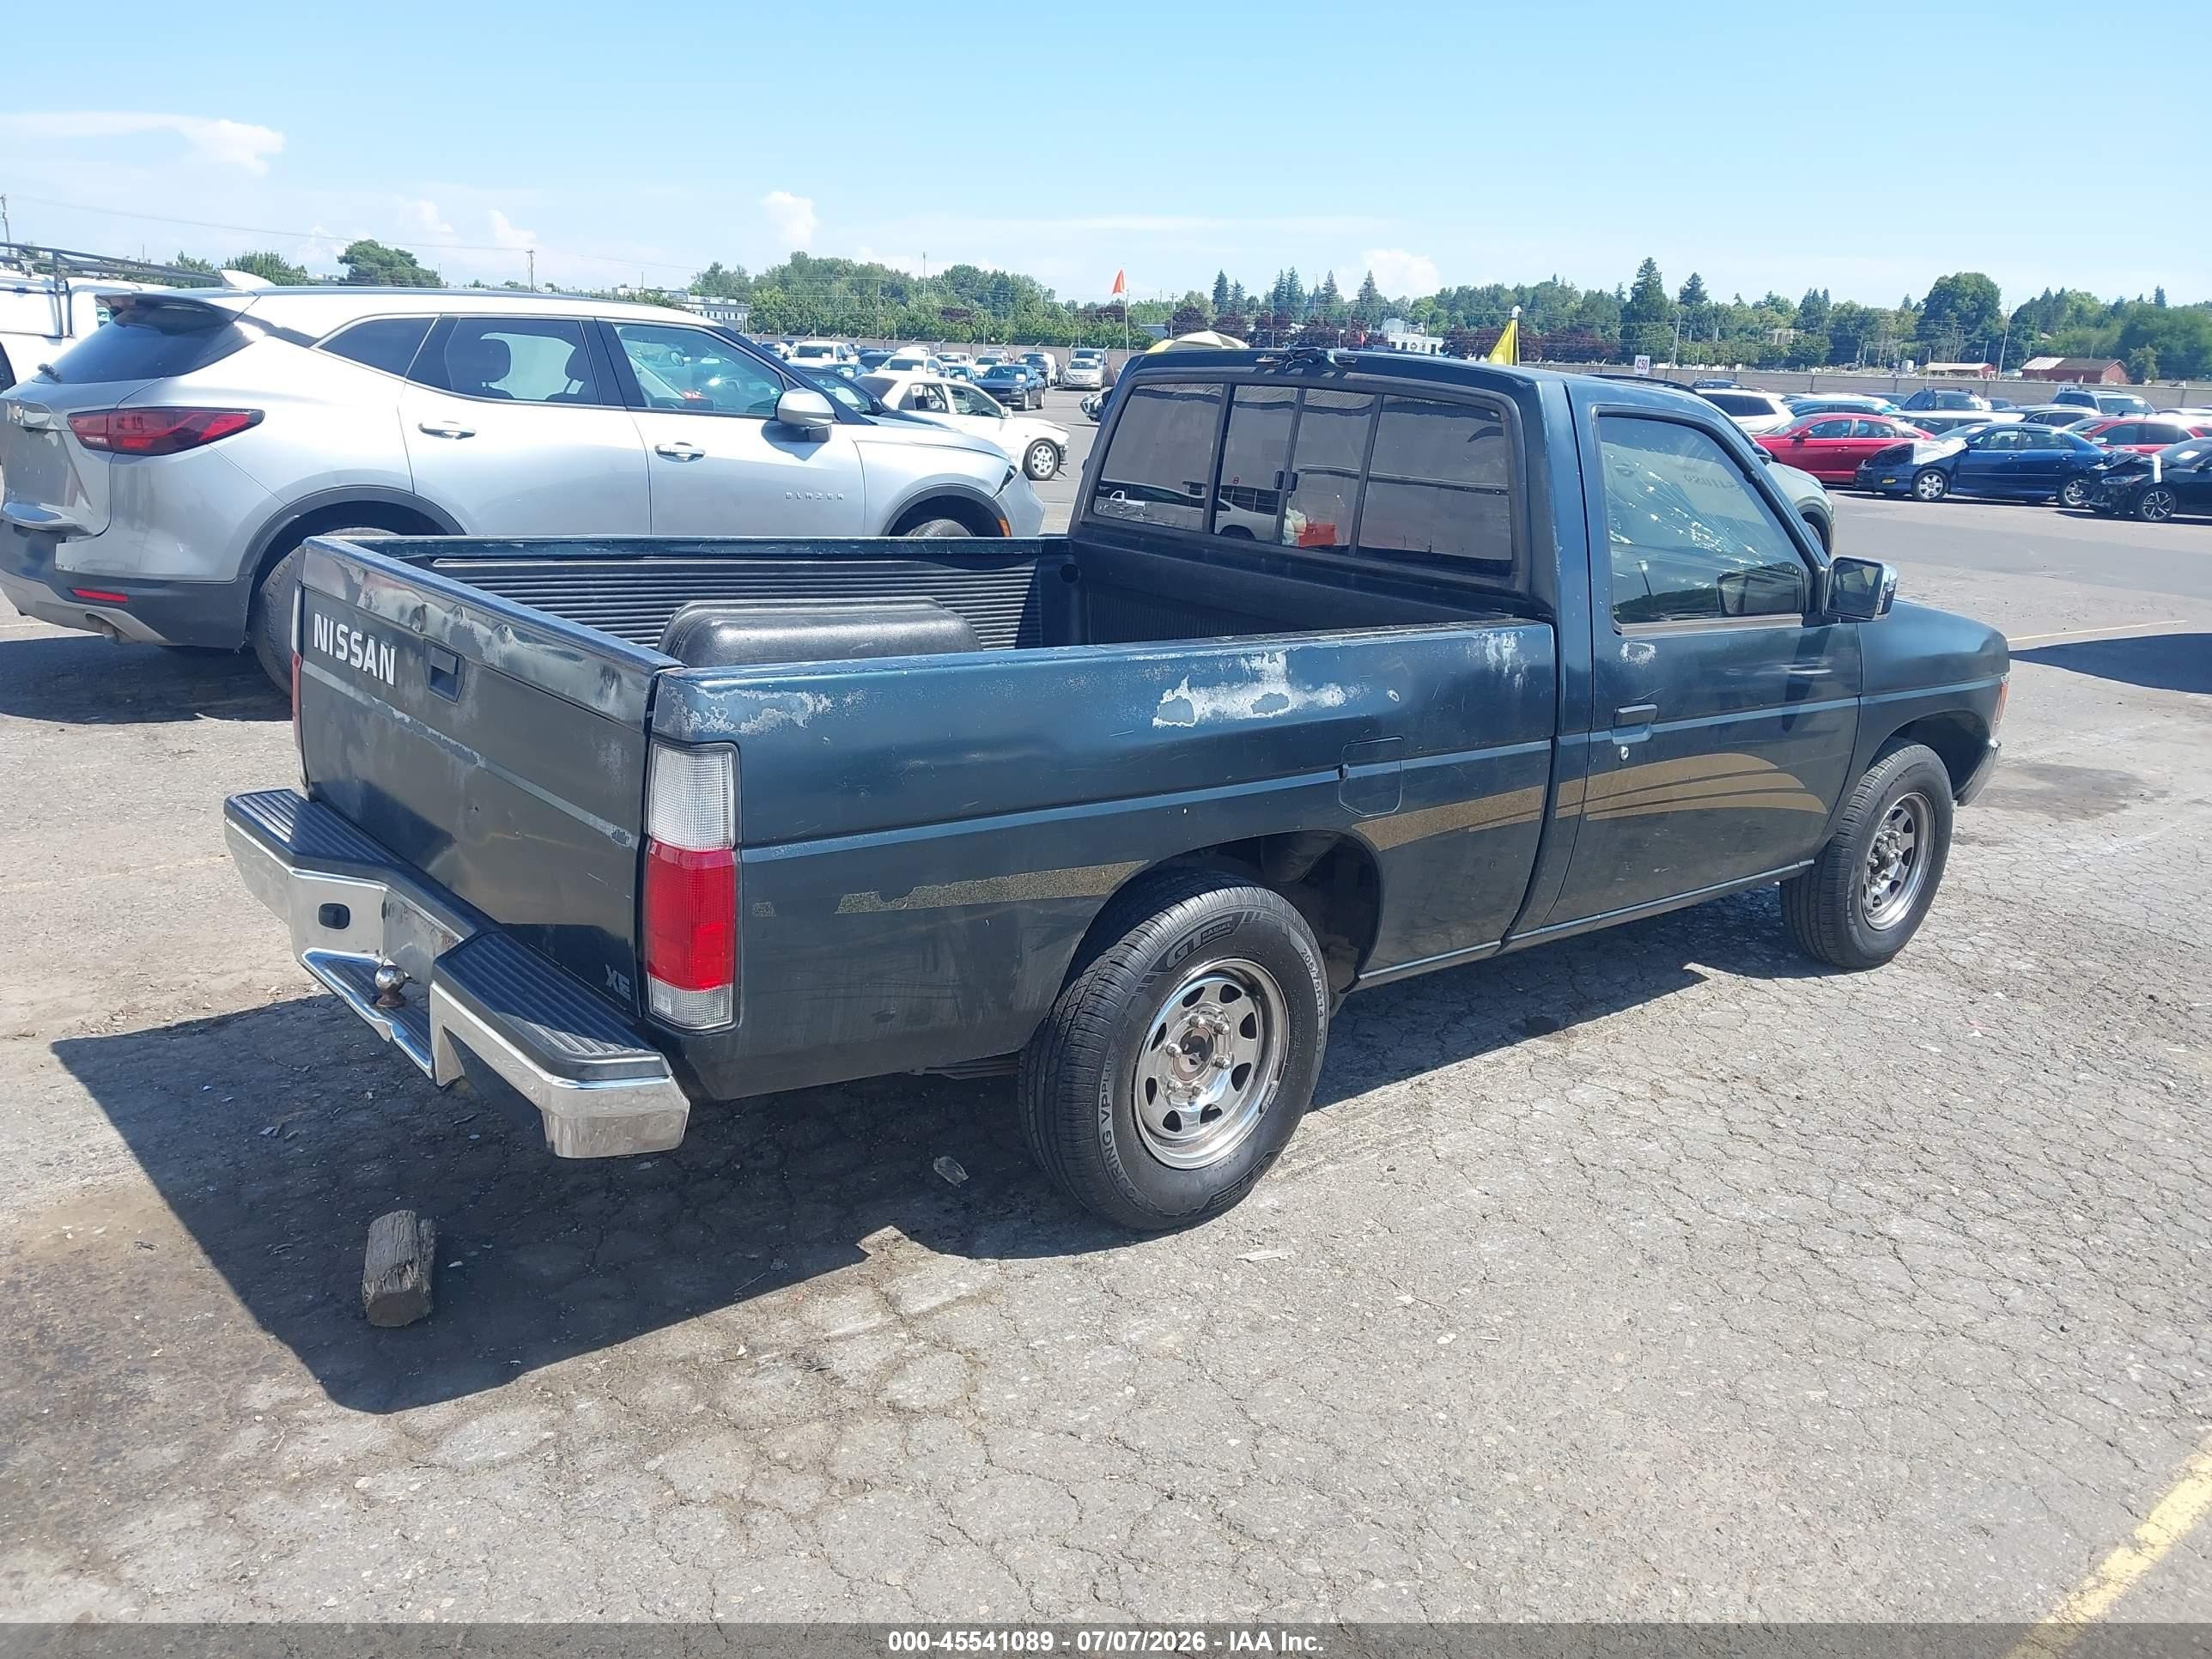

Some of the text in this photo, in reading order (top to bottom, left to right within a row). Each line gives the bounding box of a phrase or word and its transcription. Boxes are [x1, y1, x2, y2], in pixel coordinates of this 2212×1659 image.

[1637, 359, 1648, 370] C50
[785, 492, 844, 501] BLAZER
[313, 612, 396, 685] NISSAN
[1202, 921, 1231, 939] RADIAL
[605, 963, 632, 1002] XE
[1301, 948, 1325, 1018] 205/75R14
